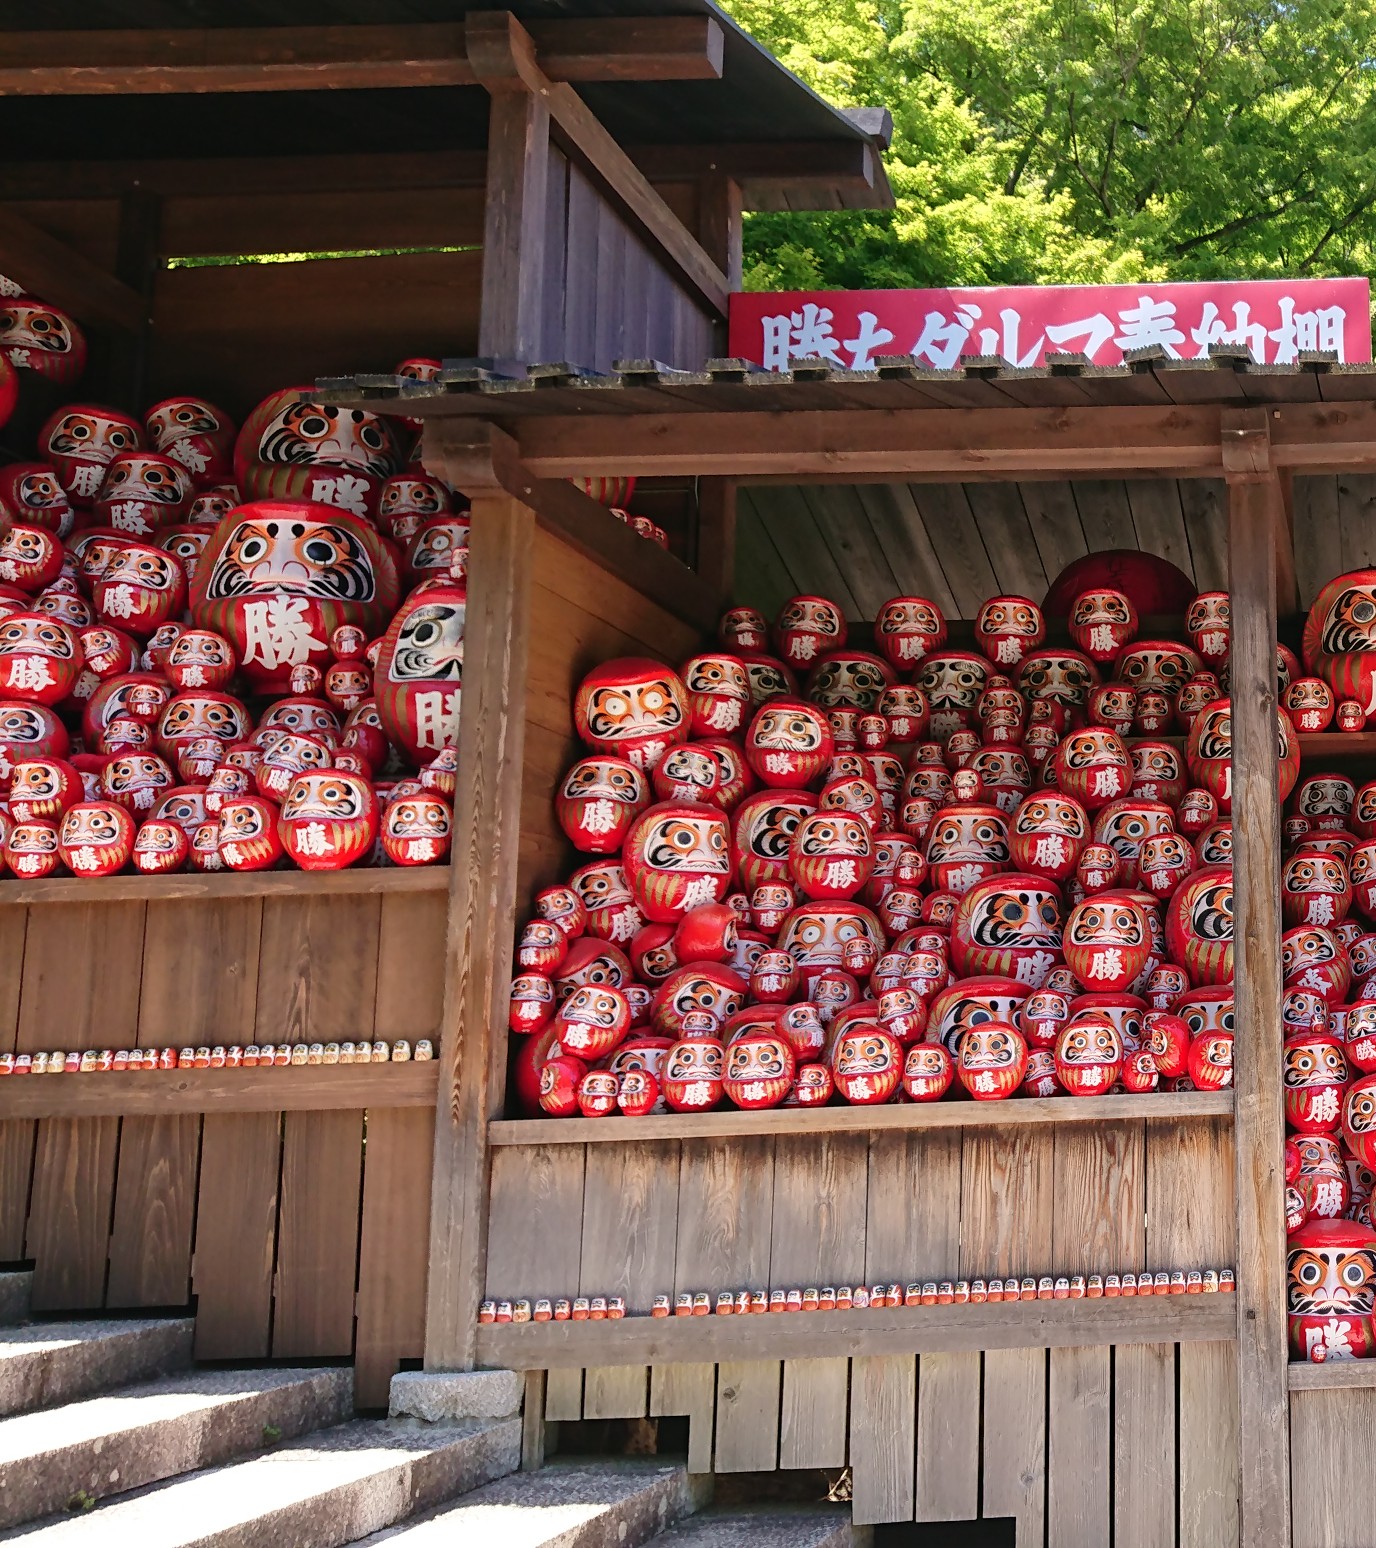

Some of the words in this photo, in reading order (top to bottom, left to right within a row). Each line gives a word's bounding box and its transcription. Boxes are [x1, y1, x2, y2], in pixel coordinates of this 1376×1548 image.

[168, 438, 211, 474] 勝
[111, 502, 154, 534] 勝
[102, 584, 142, 620] 勝
[242, 596, 328, 669] 勝
[1089, 624, 1119, 651] 勝
[1202, 632, 1229, 655] 勝
[788, 636, 817, 661] 勝
[898, 637, 926, 660] 勝
[996, 635, 1025, 665] 勝
[6, 657, 57, 691] 勝
[180, 665, 208, 687] 勝
[706, 699, 742, 732] 勝
[891, 718, 910, 736] 勝
[1300, 710, 1322, 729] 勝
[765, 754, 796, 775] 勝
[267, 768, 294, 791] 勝
[1091, 766, 1123, 797] 勝
[133, 788, 156, 809] 勝
[12, 802, 32, 822] 勝
[580, 800, 617, 834] 勝
[295, 821, 336, 855] 勝
[406, 837, 436, 861] 勝
[18, 854, 41, 872] 勝
[70, 845, 100, 870] 勝
[222, 844, 244, 864] 勝
[1031, 833, 1067, 869] 勝
[821, 859, 857, 888] 勝
[1151, 870, 1171, 890] 勝
[674, 874, 719, 911] 勝
[1304, 894, 1334, 926] 勝
[608, 906, 643, 941] 勝
[520, 946, 540, 964] 勝
[1088, 948, 1126, 980] 勝
[761, 975, 782, 992] 勝
[518, 999, 541, 1021] 勝
[563, 1023, 591, 1049] 勝
[889, 1018, 909, 1036] 勝
[1038, 1019, 1057, 1037] 勝
[847, 1077, 874, 1099] 勝
[974, 1071, 1000, 1093] 勝
[1038, 1076, 1057, 1097] 勝
[1081, 1066, 1102, 1086] 勝
[681, 1082, 712, 1106] 勝
[742, 1081, 768, 1100] 勝
[1305, 1087, 1340, 1123] 勝
[1311, 1179, 1343, 1217] 勝
